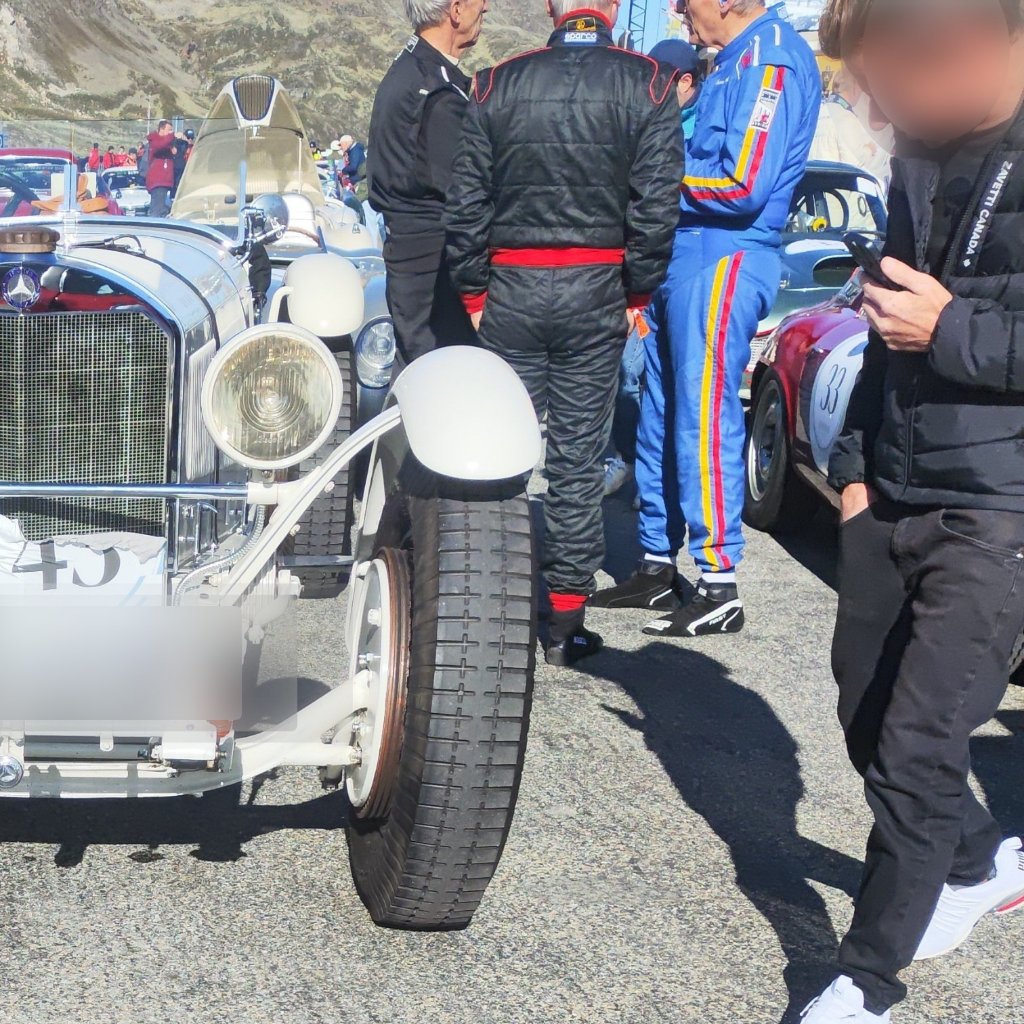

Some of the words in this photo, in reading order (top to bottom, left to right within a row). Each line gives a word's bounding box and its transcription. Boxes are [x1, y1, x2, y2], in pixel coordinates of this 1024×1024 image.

[984, 160, 1013, 207] ZAVETTI
[965, 208, 990, 255] CANADA
[820, 364, 847, 415] 33
